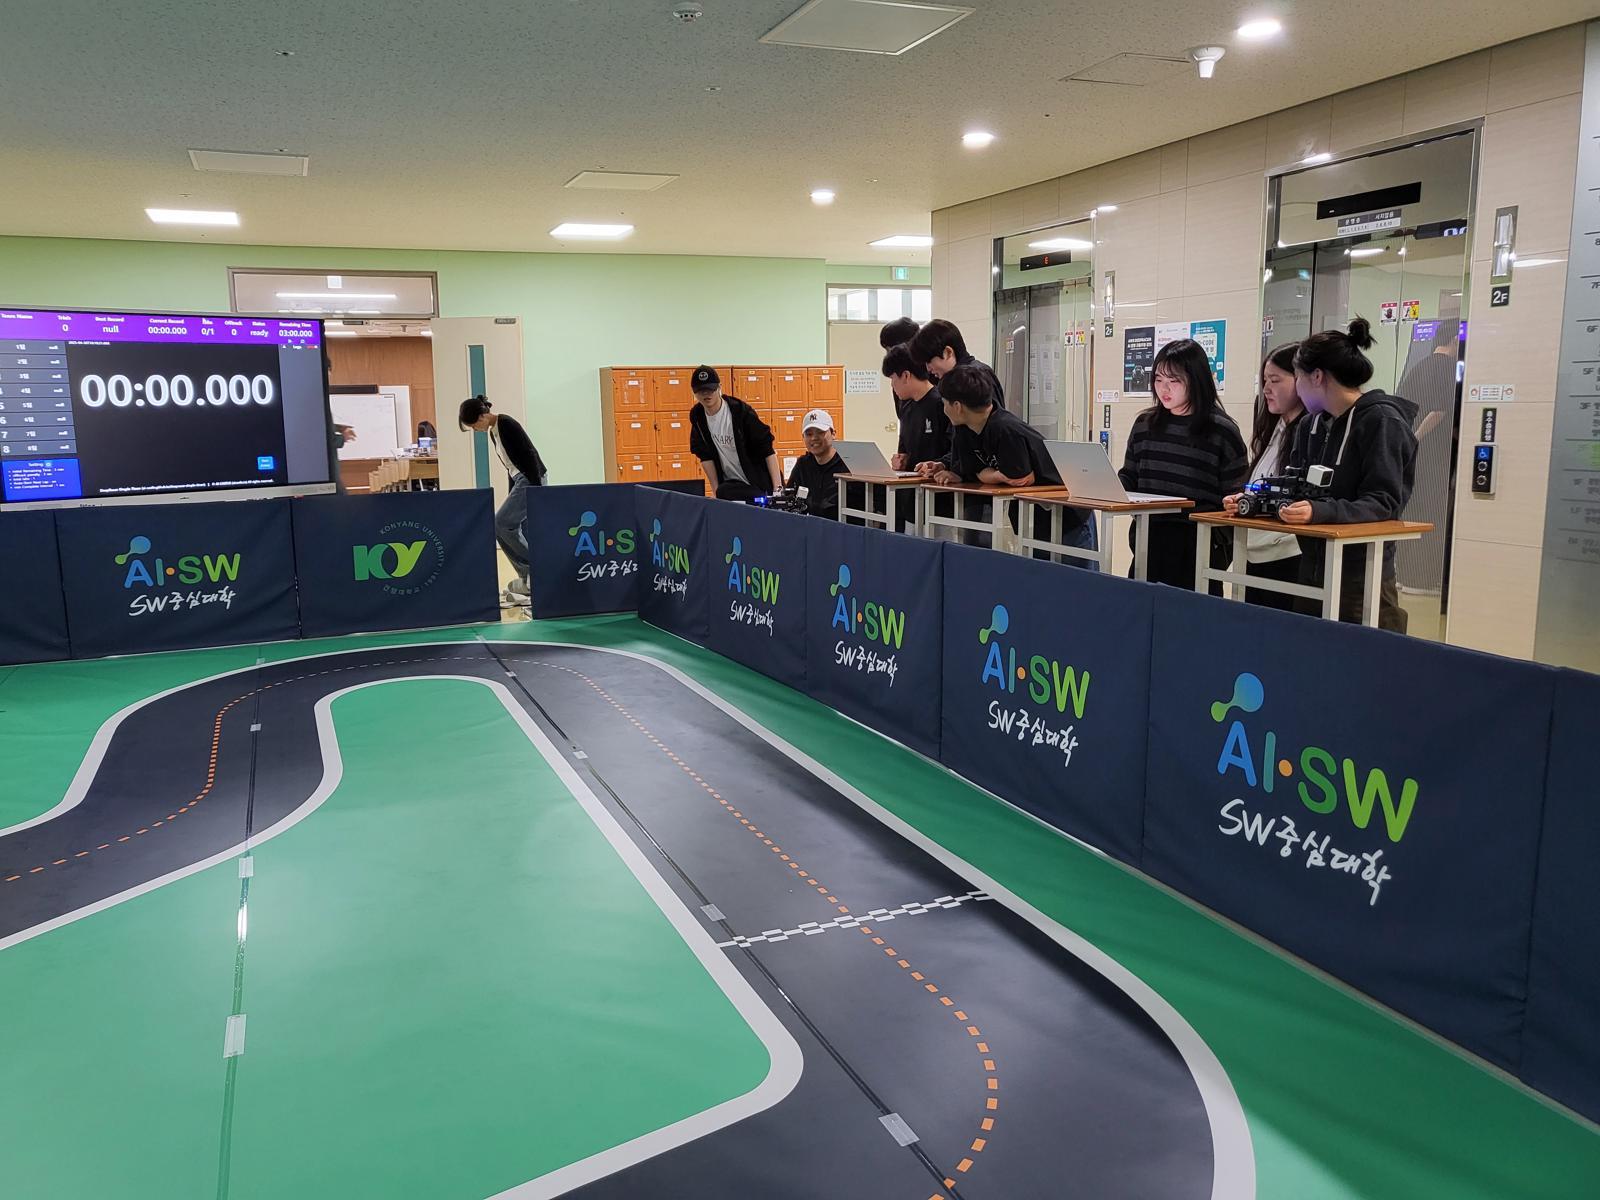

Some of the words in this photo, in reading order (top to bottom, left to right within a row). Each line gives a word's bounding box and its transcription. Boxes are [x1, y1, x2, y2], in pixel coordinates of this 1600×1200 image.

[1492, 290, 1508, 304] 2F
[62, 324, 69, 332] 0
[103, 325, 119, 333] null
[148, 326, 187, 335] 00:00.000
[201, 328, 215, 336] 0/1
[250, 330, 269, 338] ready
[278, 329, 313, 338] 03:00.000
[80, 374, 274, 407] 00:00.000
[1, 431, 8, 439] 7
[2, 445, 10, 453] 8
[380, 520, 420, 534] KONYANG
[422, 526, 445, 567] UNIVERSITY
[574, 529, 635, 557] AI·S
